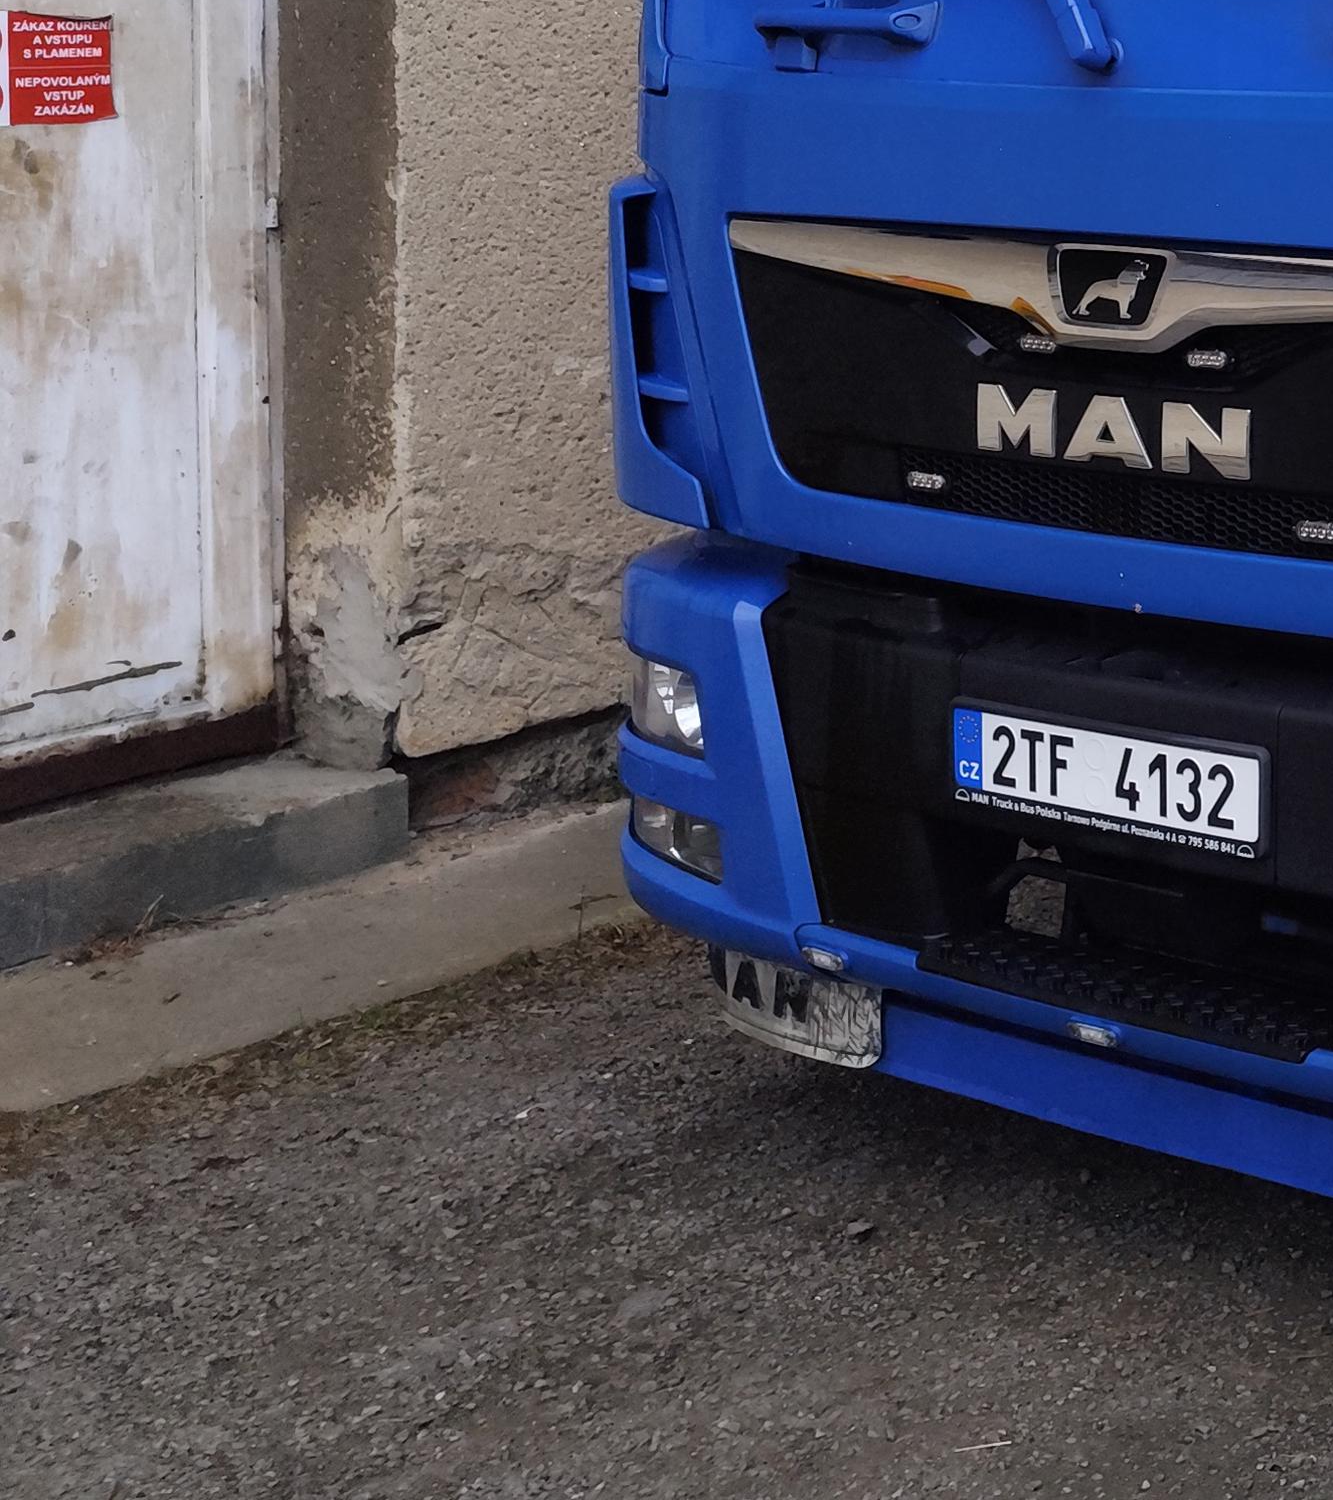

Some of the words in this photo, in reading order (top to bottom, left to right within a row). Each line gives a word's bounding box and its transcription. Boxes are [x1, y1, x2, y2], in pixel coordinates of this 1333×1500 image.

[12, 20, 54, 31] ZÁKAZ
[33, 35, 42, 45] A
[44, 34, 93, 45] VSTUPU
[23, 48, 32, 59] S
[35, 47, 102, 59] PLAMENEM
[15, 73, 111, 88] NEPOVOLANÝM
[43, 90, 85, 101] VSTUP
[34, 103, 94, 116] ZAKÁZÁN
[977, 383, 1250, 480] MAN
[958, 760, 980, 781] CZ
[992, 725, 1074, 797] 2TF
[1115, 747, 1235, 831] 4132
[971, 792, 989, 805] MAN
[992, 796, 1013, 811] Truck
[1020, 802, 1035, 815] Bus
[1036, 805, 1061, 820] Polska
[1188, 836, 1203, 848] 795
[1220, 842, 1235, 854] 841
